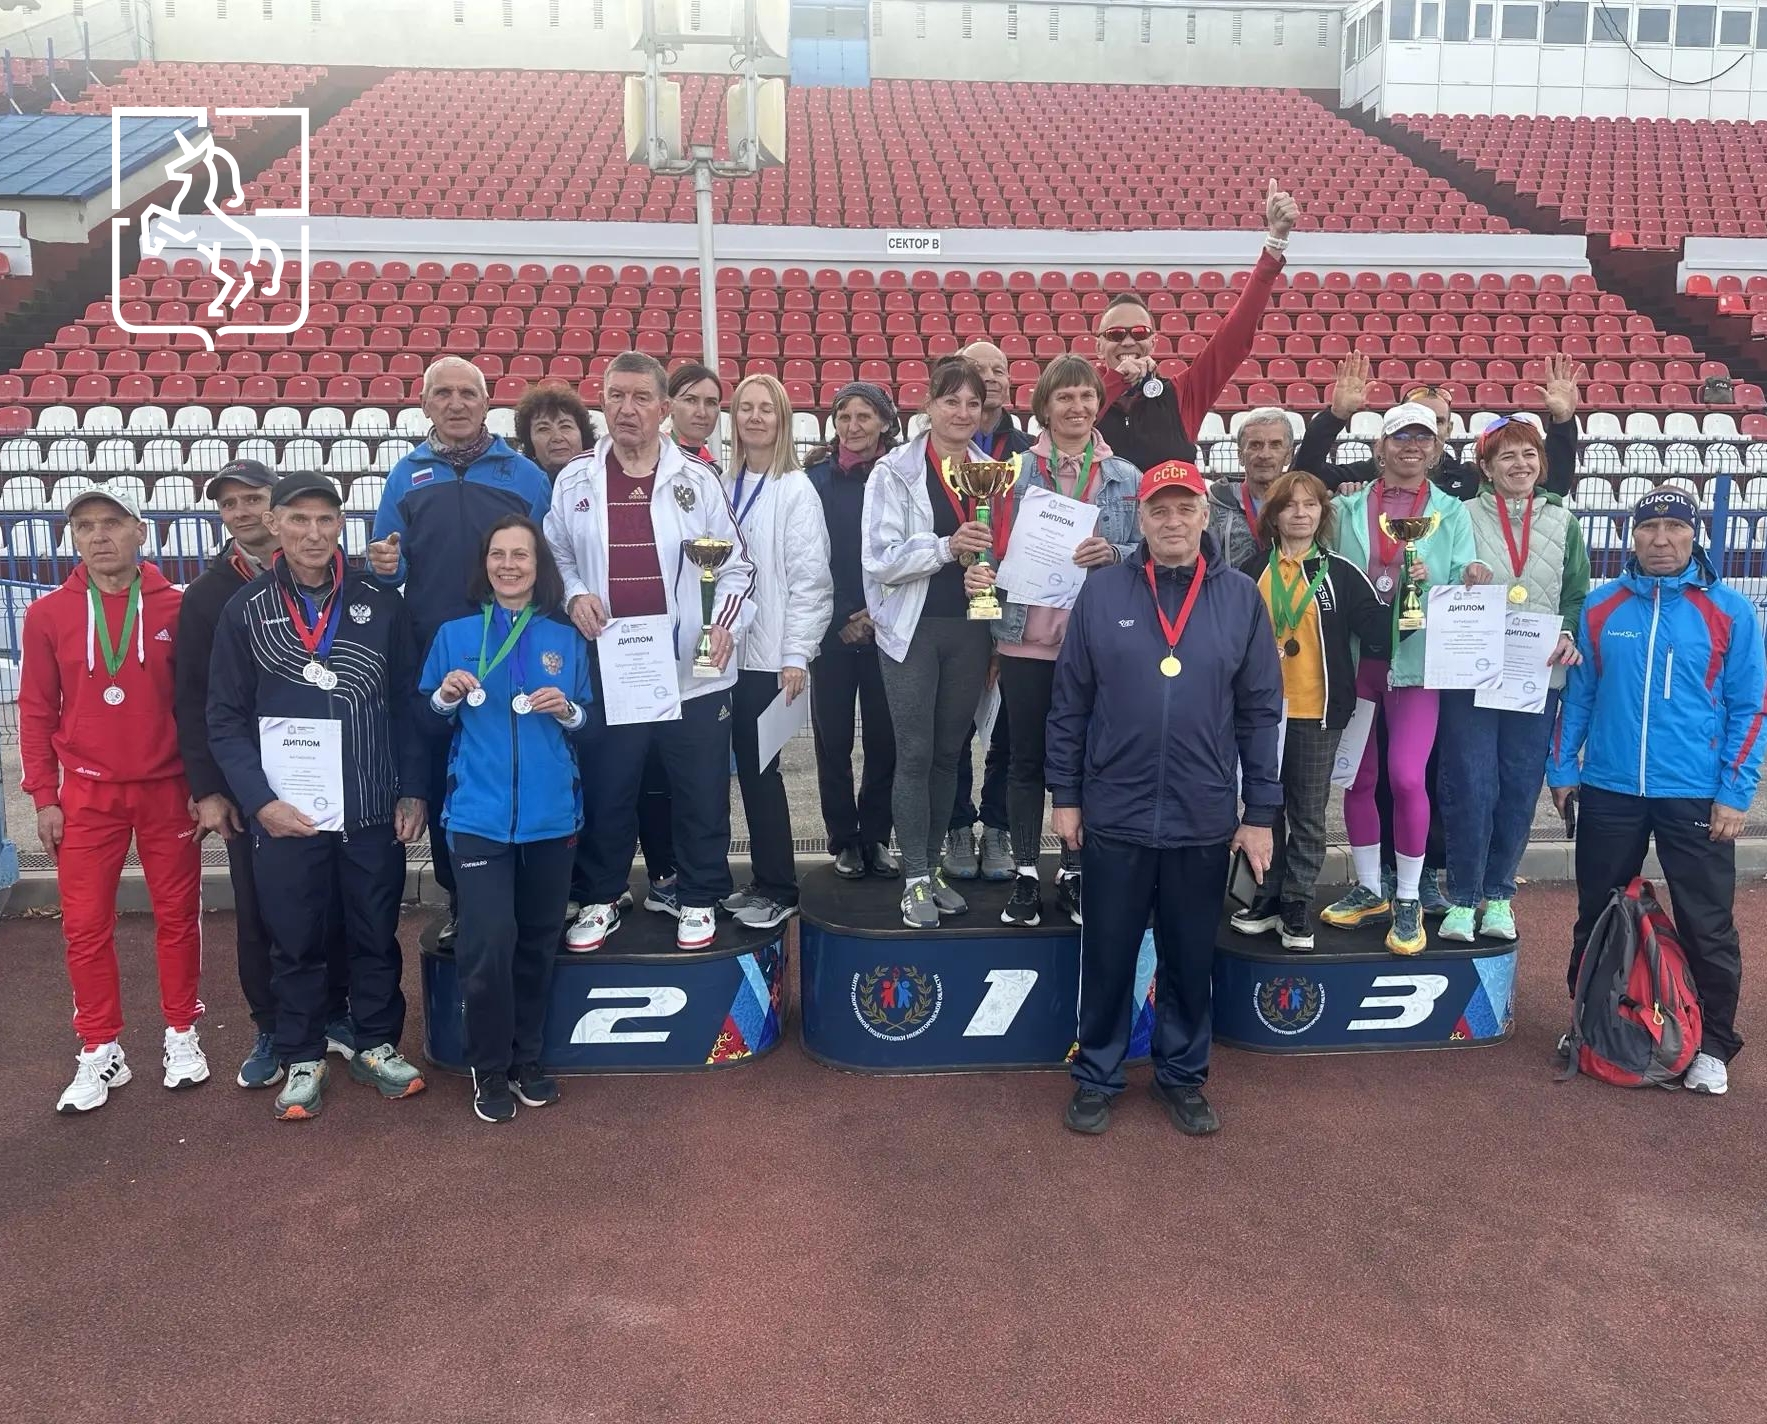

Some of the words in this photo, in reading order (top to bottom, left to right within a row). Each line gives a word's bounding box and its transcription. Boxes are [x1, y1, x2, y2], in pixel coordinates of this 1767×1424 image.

[888, 238, 930, 249] СЕКТОР
[932, 238, 940, 249] В
[1153, 467, 1188, 483] СССР
[1640, 494, 1688, 508] LUKOIL
[1039, 510, 1075, 528] ДИПЛОМ
[1447, 604, 1485, 613] ДИПЛОМ
[617, 635, 654, 646] ДИПЛОМ
[1504, 628, 1541, 639] ДИПЛОМ
[282, 738, 321, 748] ДИПЛОМ
[962, 969, 1039, 1036] 1
[1346, 974, 1449, 1031] 3
[569, 986, 688, 1044] 2
